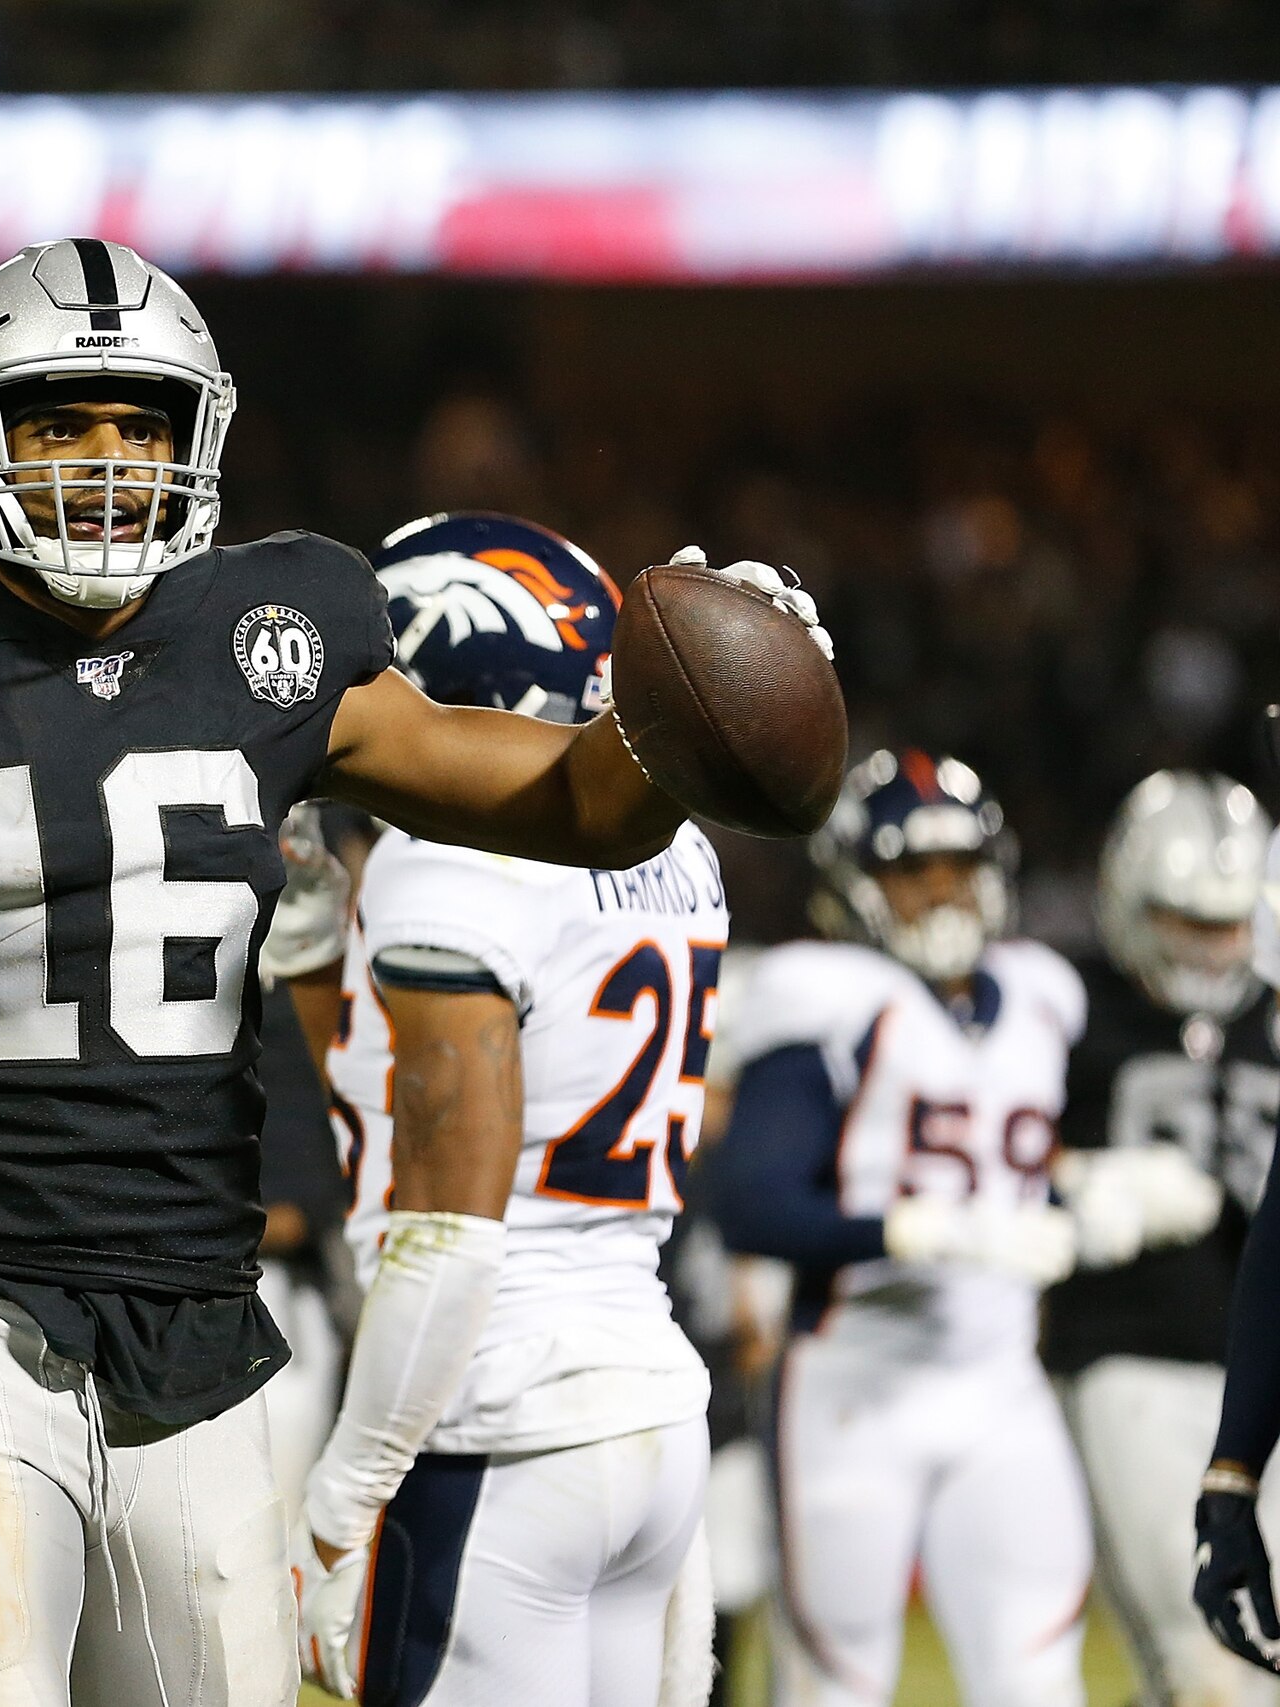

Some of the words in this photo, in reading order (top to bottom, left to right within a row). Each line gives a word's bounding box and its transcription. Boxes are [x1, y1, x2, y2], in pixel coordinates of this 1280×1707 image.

[75, 336, 140, 348] RAIDERS
[235, 620, 255, 678] AMERICAN
[308, 629, 322, 680] LEAGUE
[251, 627, 312, 676] 60
[535, 937, 729, 1212] 25
